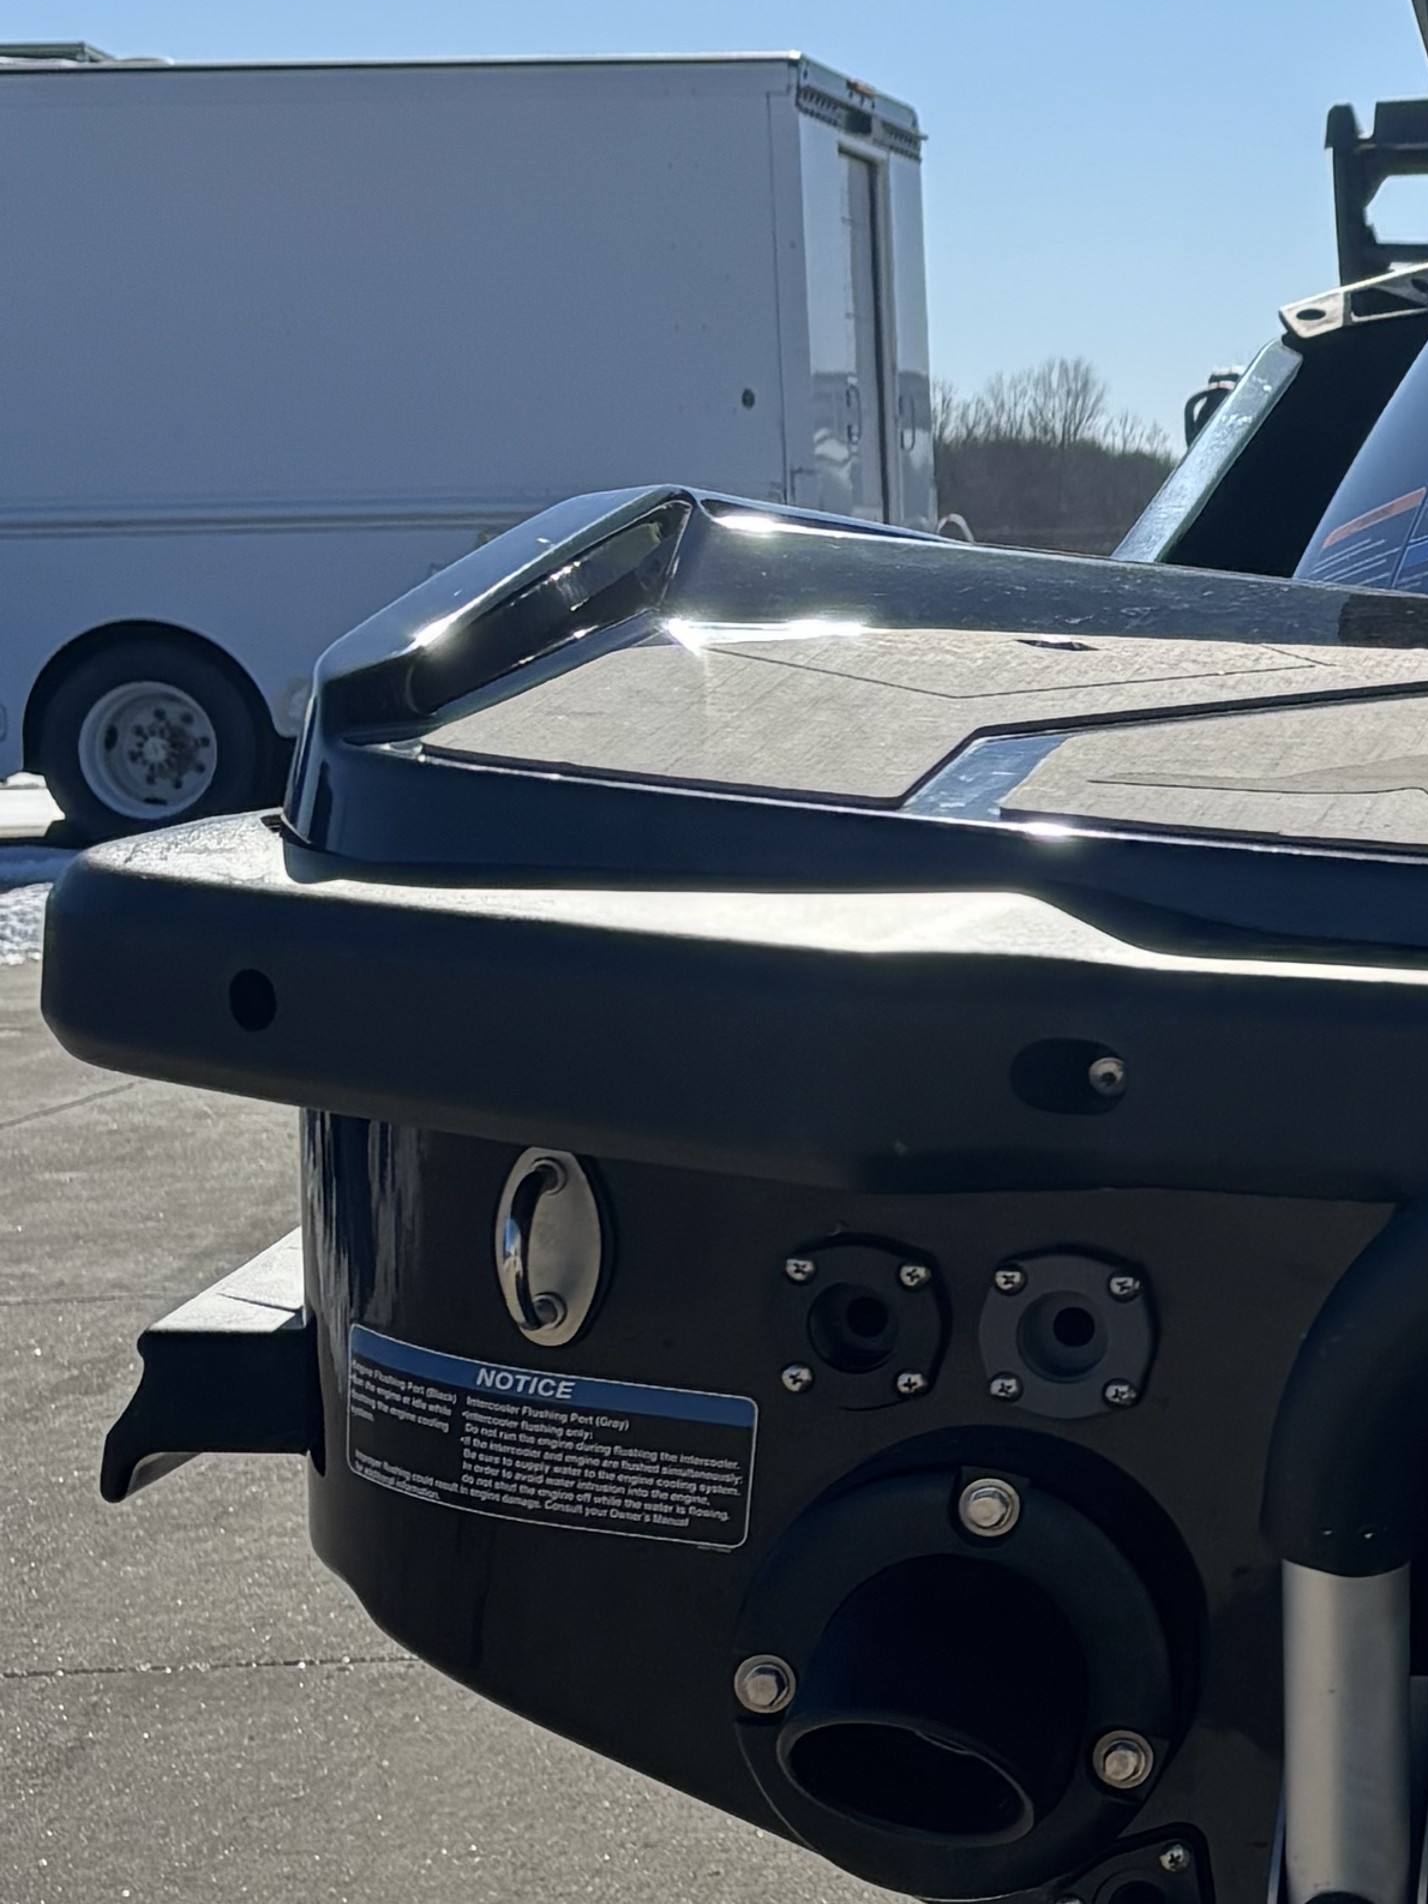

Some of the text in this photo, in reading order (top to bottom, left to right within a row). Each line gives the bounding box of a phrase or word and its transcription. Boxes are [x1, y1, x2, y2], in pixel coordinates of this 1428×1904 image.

[475, 1367, 575, 1400] NOTICE
[466, 1395, 629, 1432] Intercooler Flushing Port (Gray)
[520, 1420, 563, 1437] flushing
[464, 1422, 478, 1433] Do
[480, 1425, 496, 1437] not
[499, 1430, 516, 1441] run
[518, 1432, 535, 1444] the
[538, 1436, 573, 1451] engine
[576, 1441, 611, 1456] during
[613, 1445, 657, 1462] flushing
[660, 1451, 677, 1462] the
[489, 1440, 541, 1458] intercooler
[543, 1449, 562, 1461] and
[564, 1453, 599, 1468] engine
[601, 1458, 619, 1469] are
[621, 1459, 659, 1473] flushed
[462, 1447, 476, 1459] Be
[478, 1451, 500, 1464] sure
[502, 1456, 512, 1466] to
[515, 1457, 550, 1473] supply
[553, 1464, 581, 1476] water
[584, 1468, 595, 1478] to
[598, 1470, 615, 1481] the
[617, 1472, 654, 1487] engine
[656, 1477, 696, 1493] cooling
[473, 1462, 499, 1476] order
[502, 1468, 512, 1479] to
[514, 1470, 543, 1484] avoid
[546, 1475, 575, 1488] water
[576, 1479, 625, 1495] intrusion
[627, 1486, 648, 1497] into
[650, 1489, 668, 1499] the
[461, 1472, 473, 1484] do
[476, 1476, 492, 1488] not
[519, 1484, 535, 1495] the
[537, 1487, 573, 1503] engine
[576, 1491, 591, 1503] off
[593, 1494, 622, 1507] while
[624, 1498, 641, 1509] the
[644, 1500, 673, 1513] water
[545, 1499, 582, 1514] Consult
[584, 1506, 606, 1519] your
